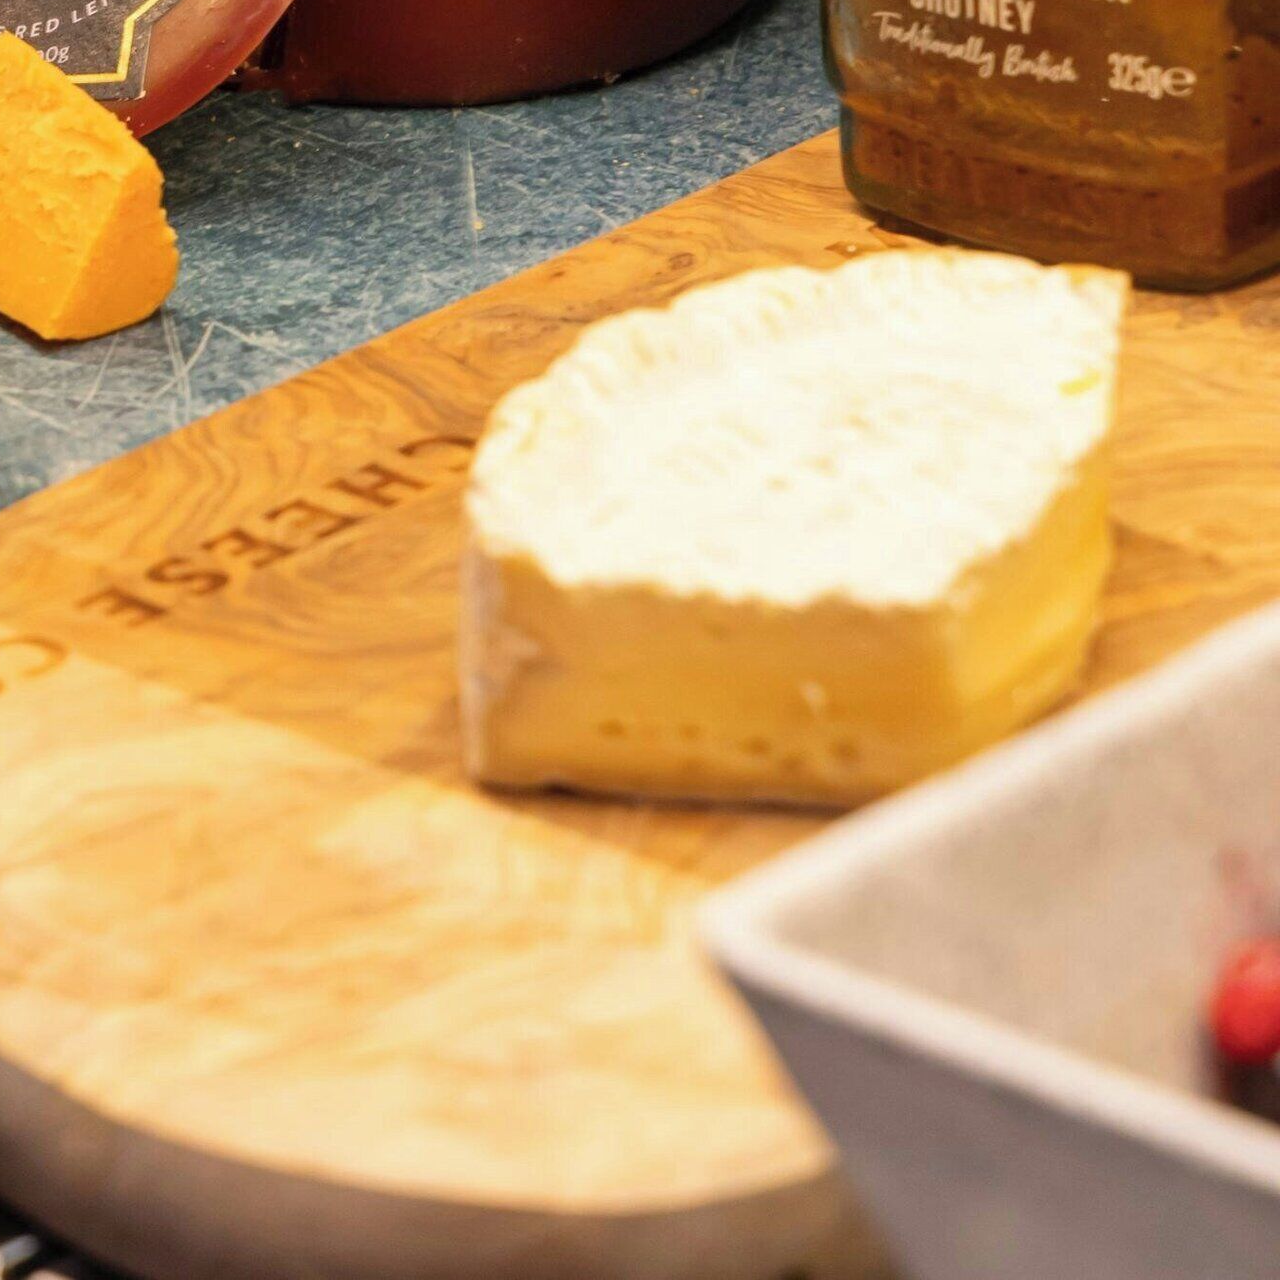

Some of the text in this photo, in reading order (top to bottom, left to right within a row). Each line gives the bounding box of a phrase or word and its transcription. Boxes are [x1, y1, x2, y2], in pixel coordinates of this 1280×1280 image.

[14, 17, 60, 39] RED
[1001, 43, 1080, 83] British
[78, 434, 477, 628] CHEESE
